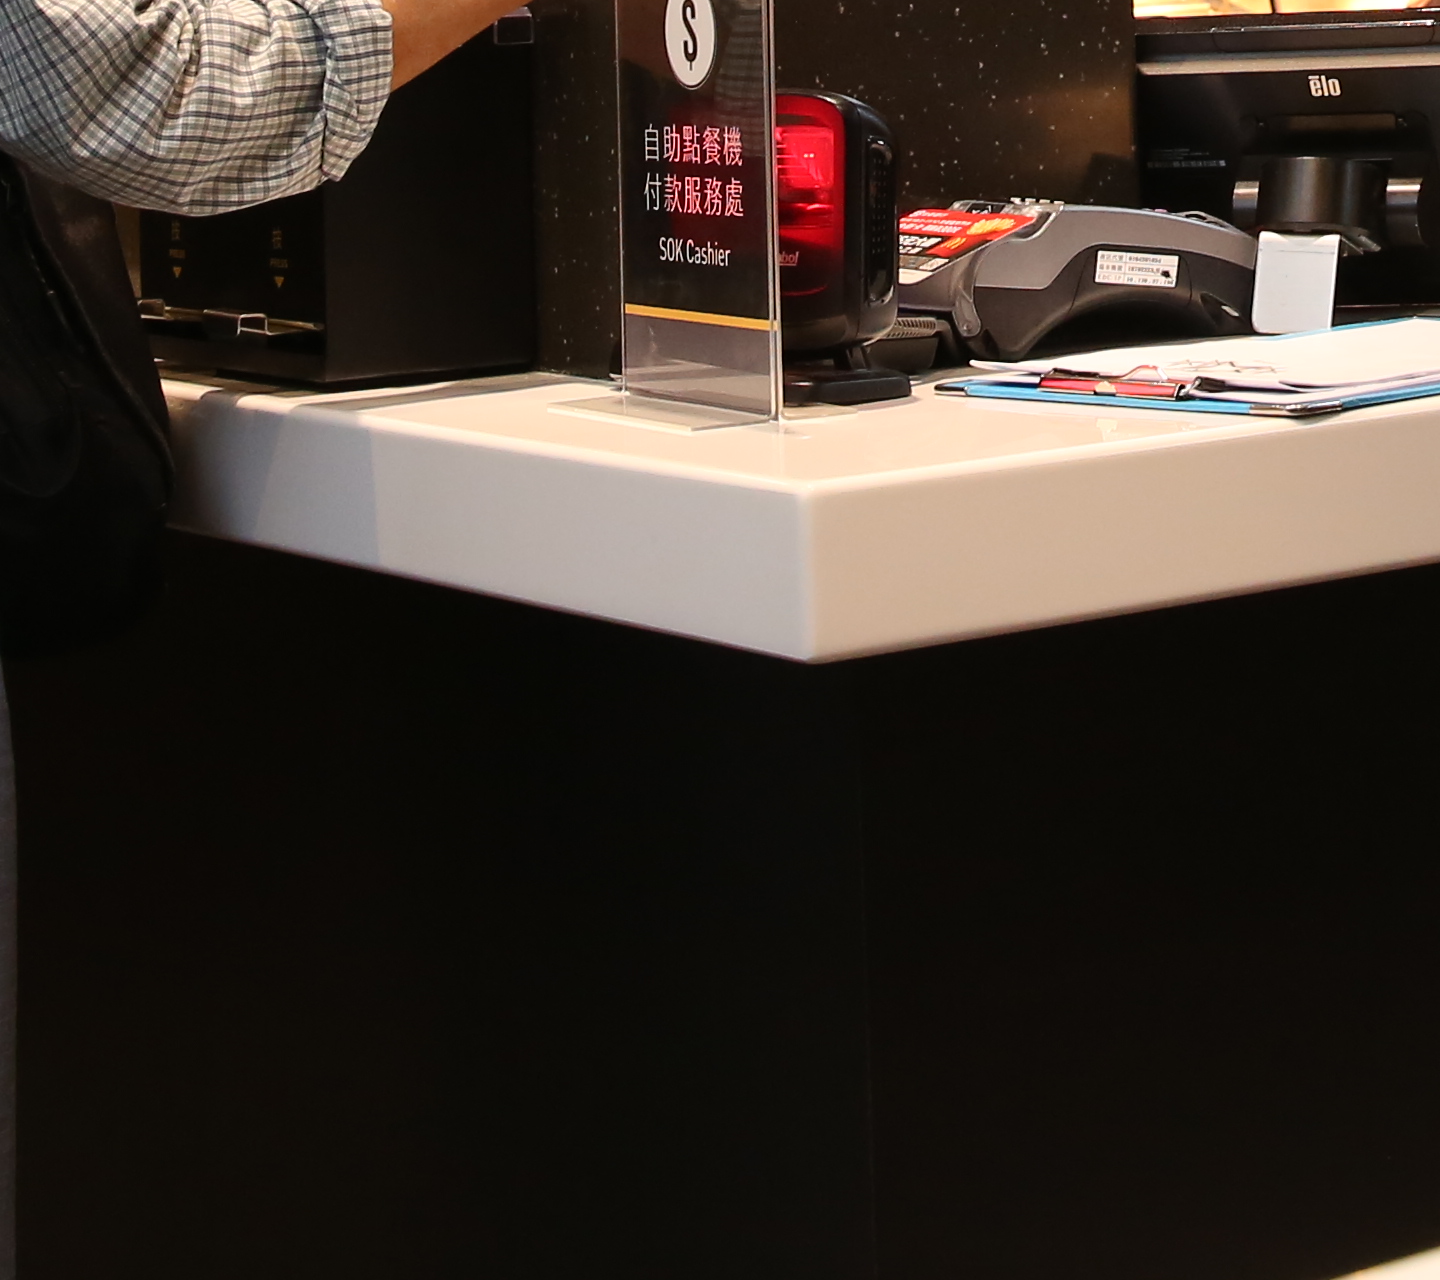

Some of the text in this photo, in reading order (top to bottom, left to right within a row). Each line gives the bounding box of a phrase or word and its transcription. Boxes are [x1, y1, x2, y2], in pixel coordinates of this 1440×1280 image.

[644, 123, 743, 167] 自助點餐機
[644, 172, 744, 217] 付款服務處
[659, 237, 731, 267] SOK Cashier
